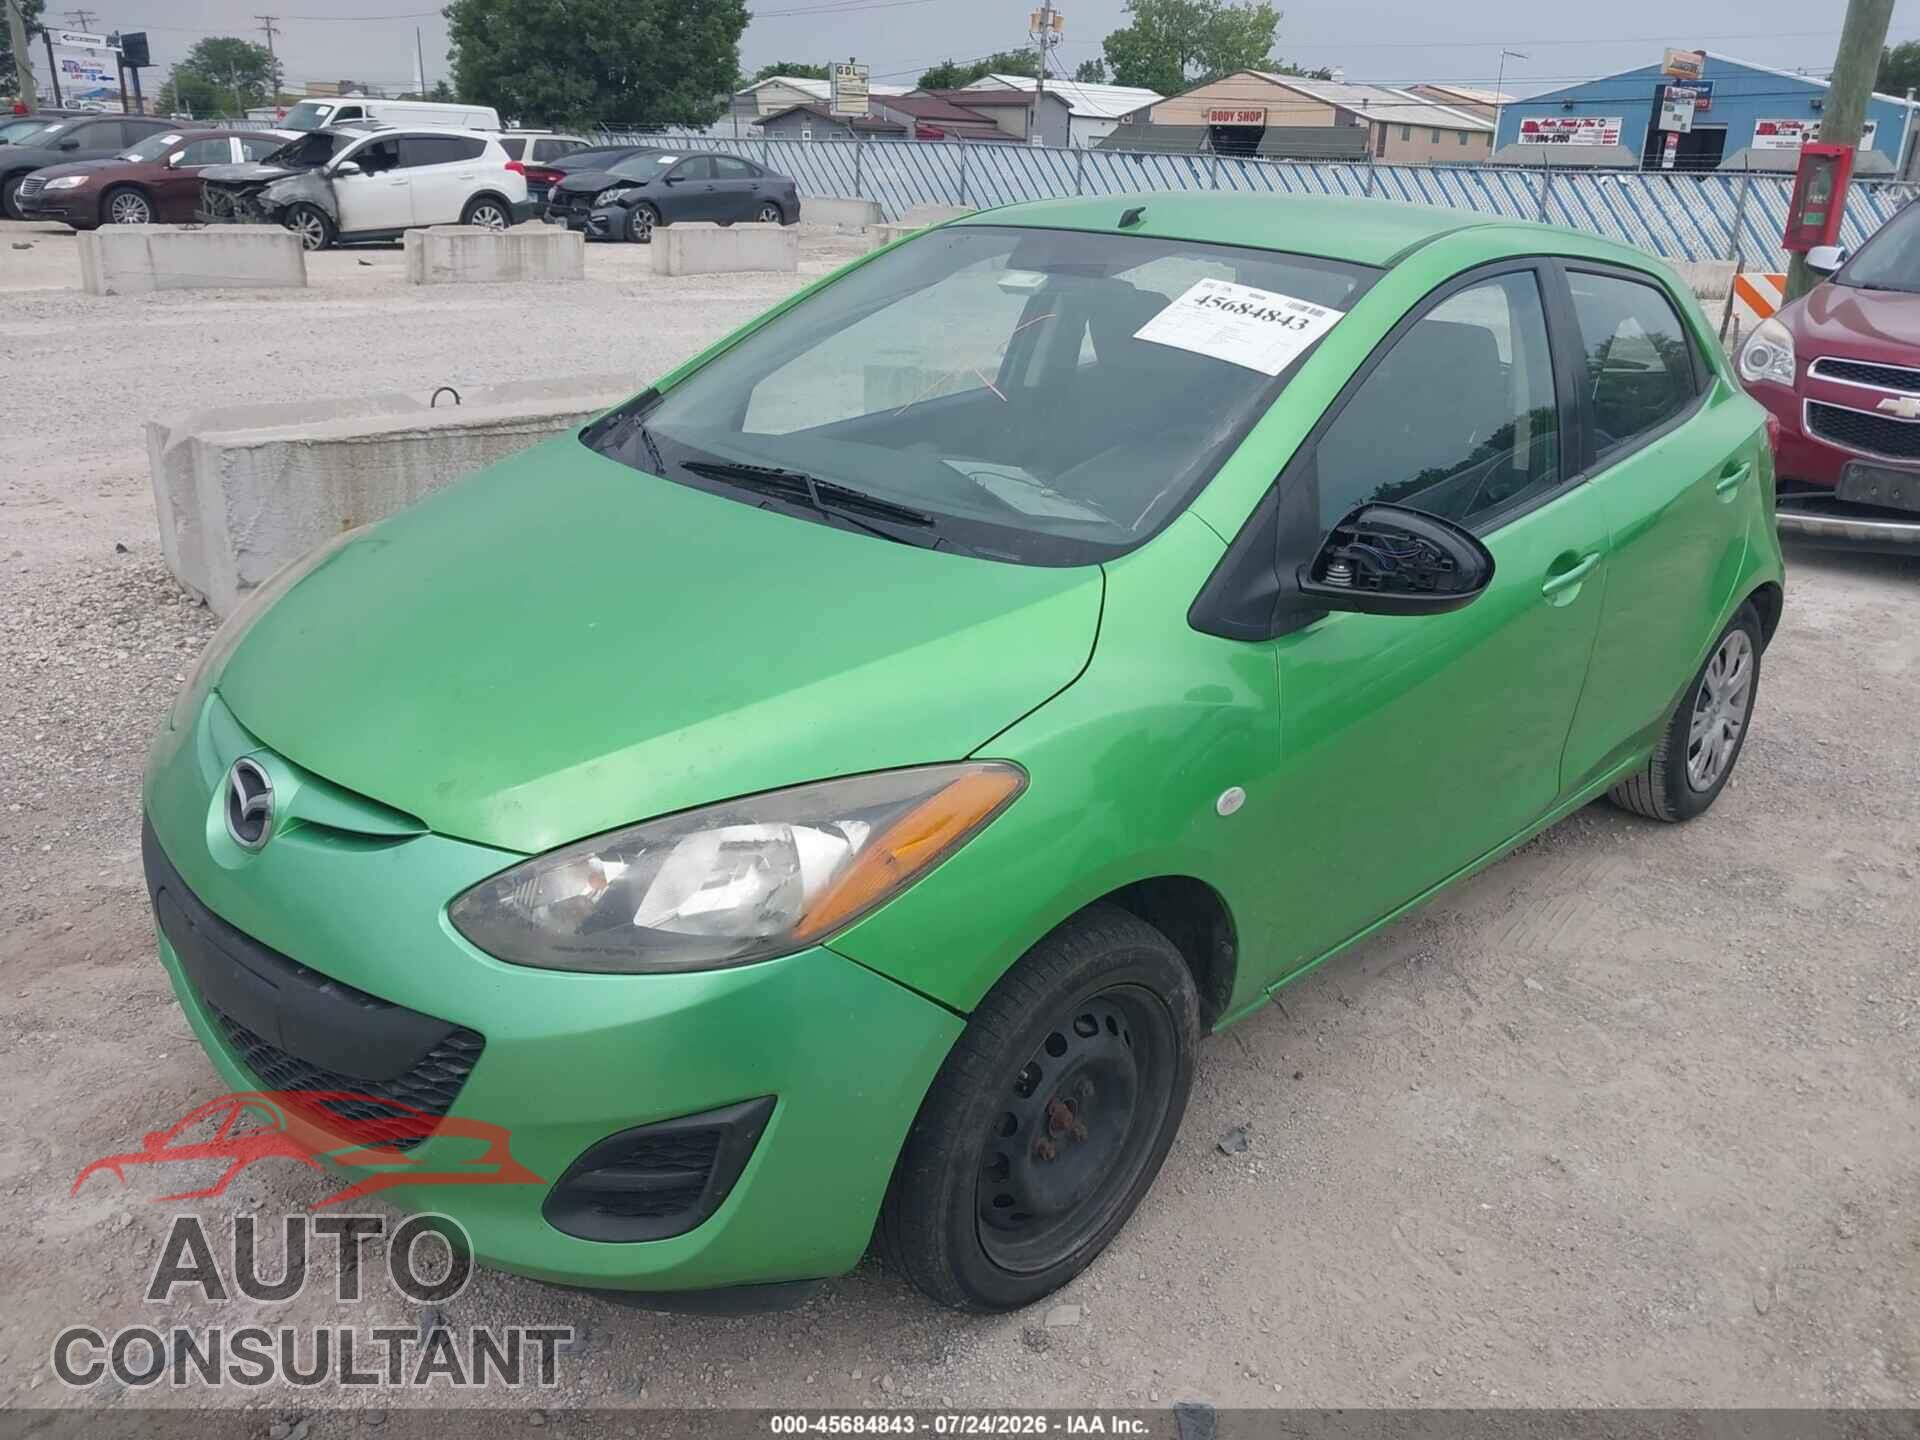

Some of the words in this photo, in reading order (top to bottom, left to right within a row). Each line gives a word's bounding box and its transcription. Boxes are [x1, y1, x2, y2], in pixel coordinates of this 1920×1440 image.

[837, 66, 857, 76] GDL
[1211, 111, 1235, 121] BODY
[1237, 111, 1262, 122] SHOP
[1194, 294, 1309, 331] 45684843
